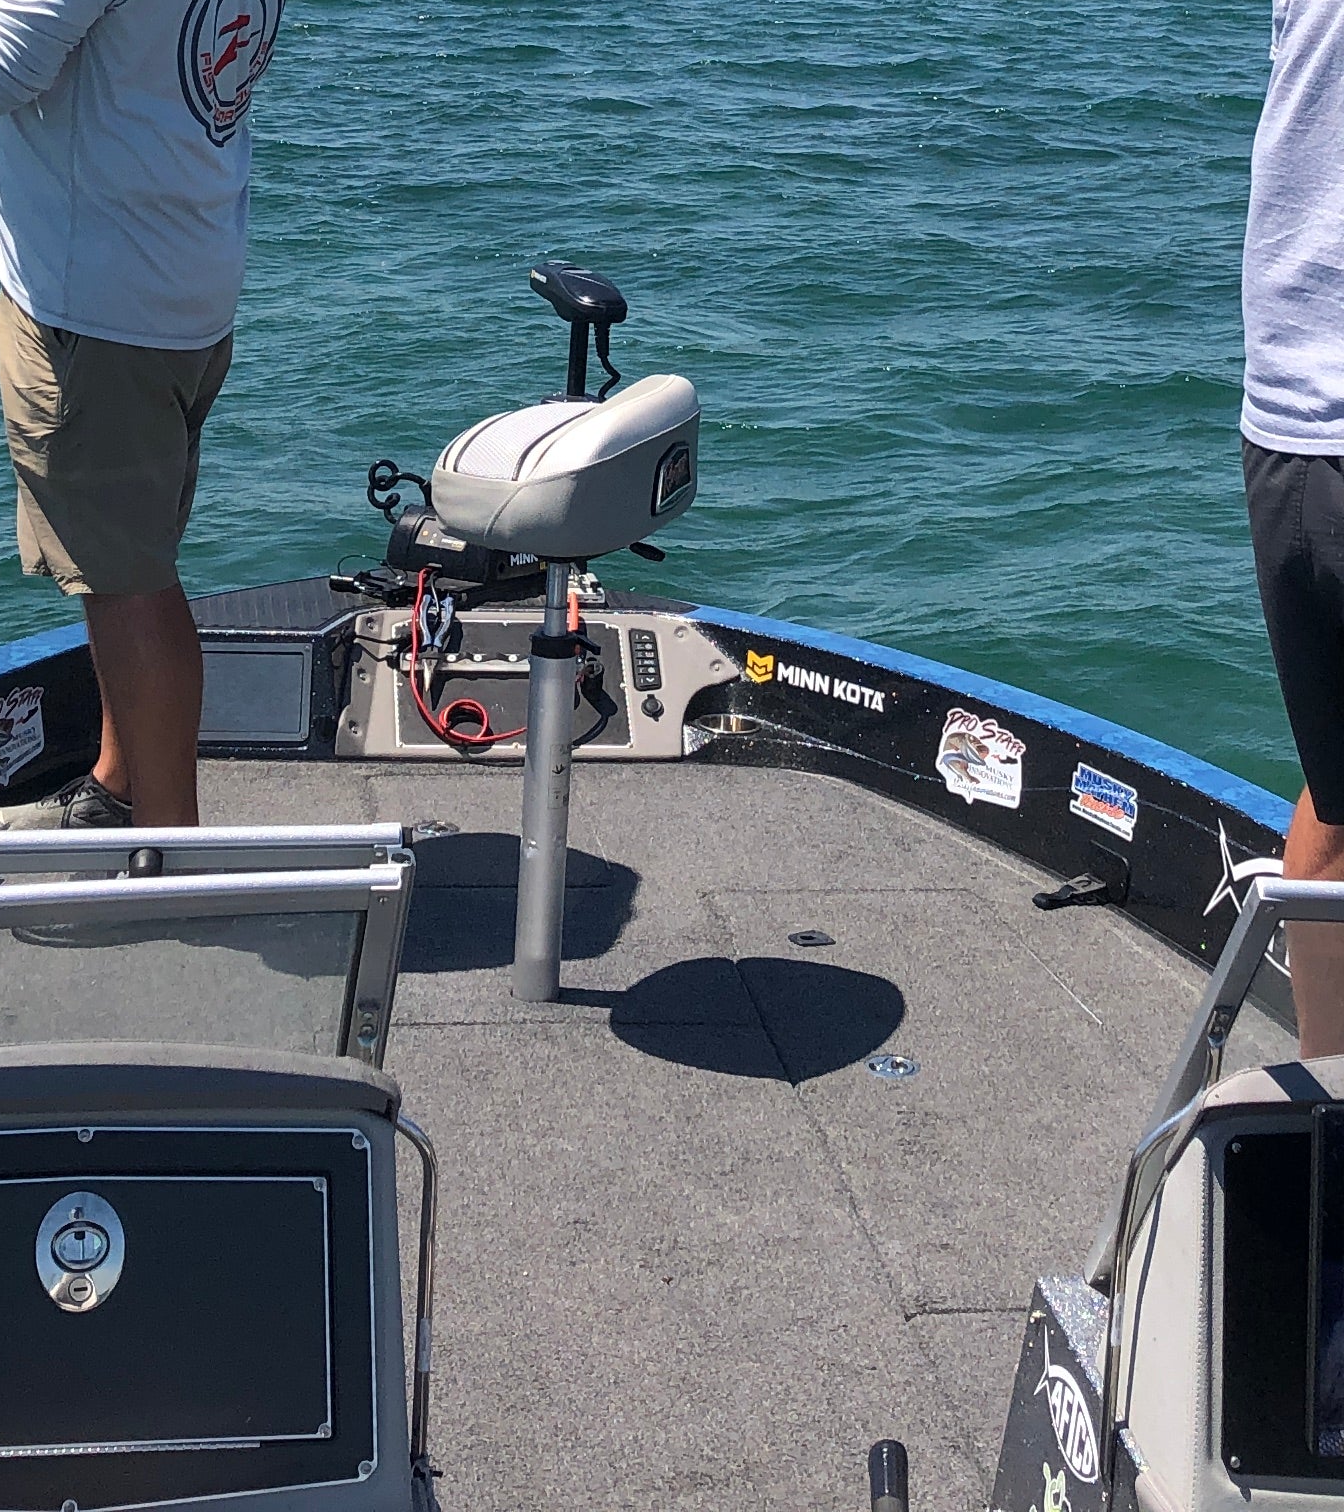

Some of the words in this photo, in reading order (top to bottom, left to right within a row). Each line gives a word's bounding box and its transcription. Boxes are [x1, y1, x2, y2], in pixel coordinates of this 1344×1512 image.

[777, 662, 830, 696] MINN
[833, 677, 885, 713] KOTA
[944, 711, 978, 733] PRO
[979, 721, 1025, 757] STAFF
[1079, 766, 1135, 802] MUSKY
